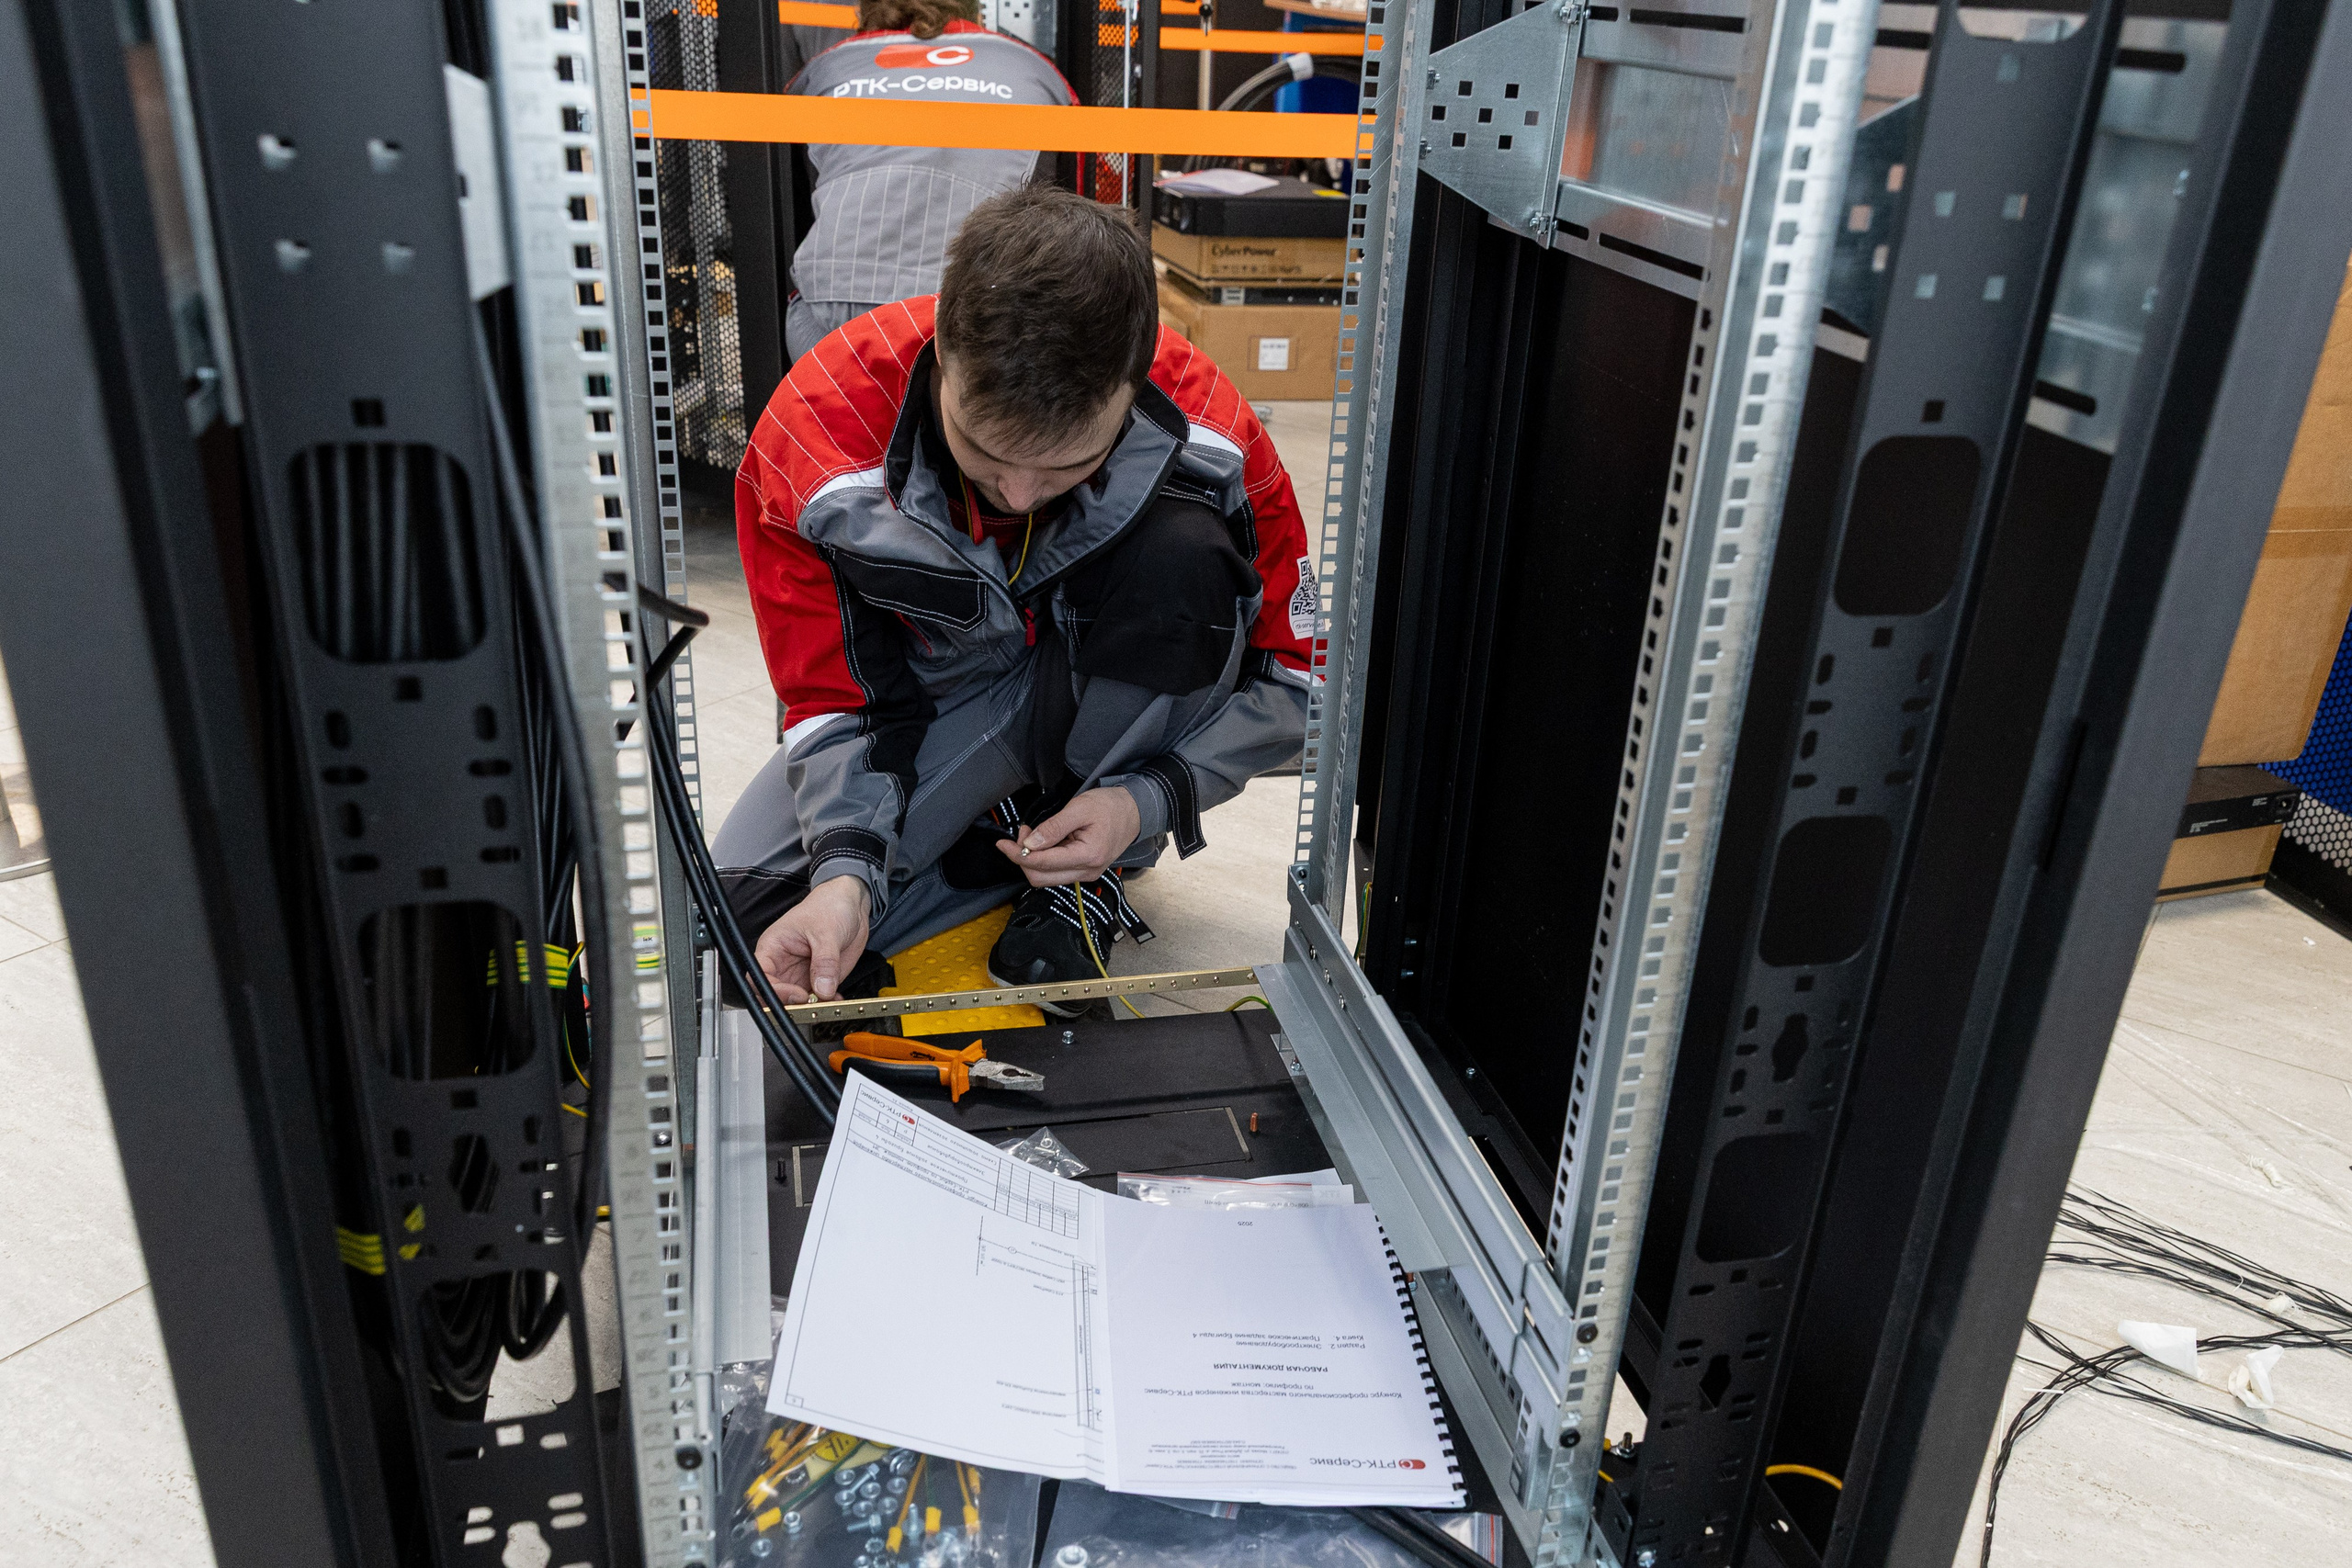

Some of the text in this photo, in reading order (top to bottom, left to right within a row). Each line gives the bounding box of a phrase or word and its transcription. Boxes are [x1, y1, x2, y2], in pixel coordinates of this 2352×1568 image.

[833, 75, 1013, 99] РТК-Сервис
[1236, 1341, 1321, 1350] Электрооборудование
[1213, 1363, 1284, 1371] ДОКУМЕНТАЦИЯ
[1144, 1388, 1193, 1396] РТК-Сервис
[1288, 1392, 1368, 1400] профессионального
[1309, 1457, 1396, 1469] РТК-Сервис
